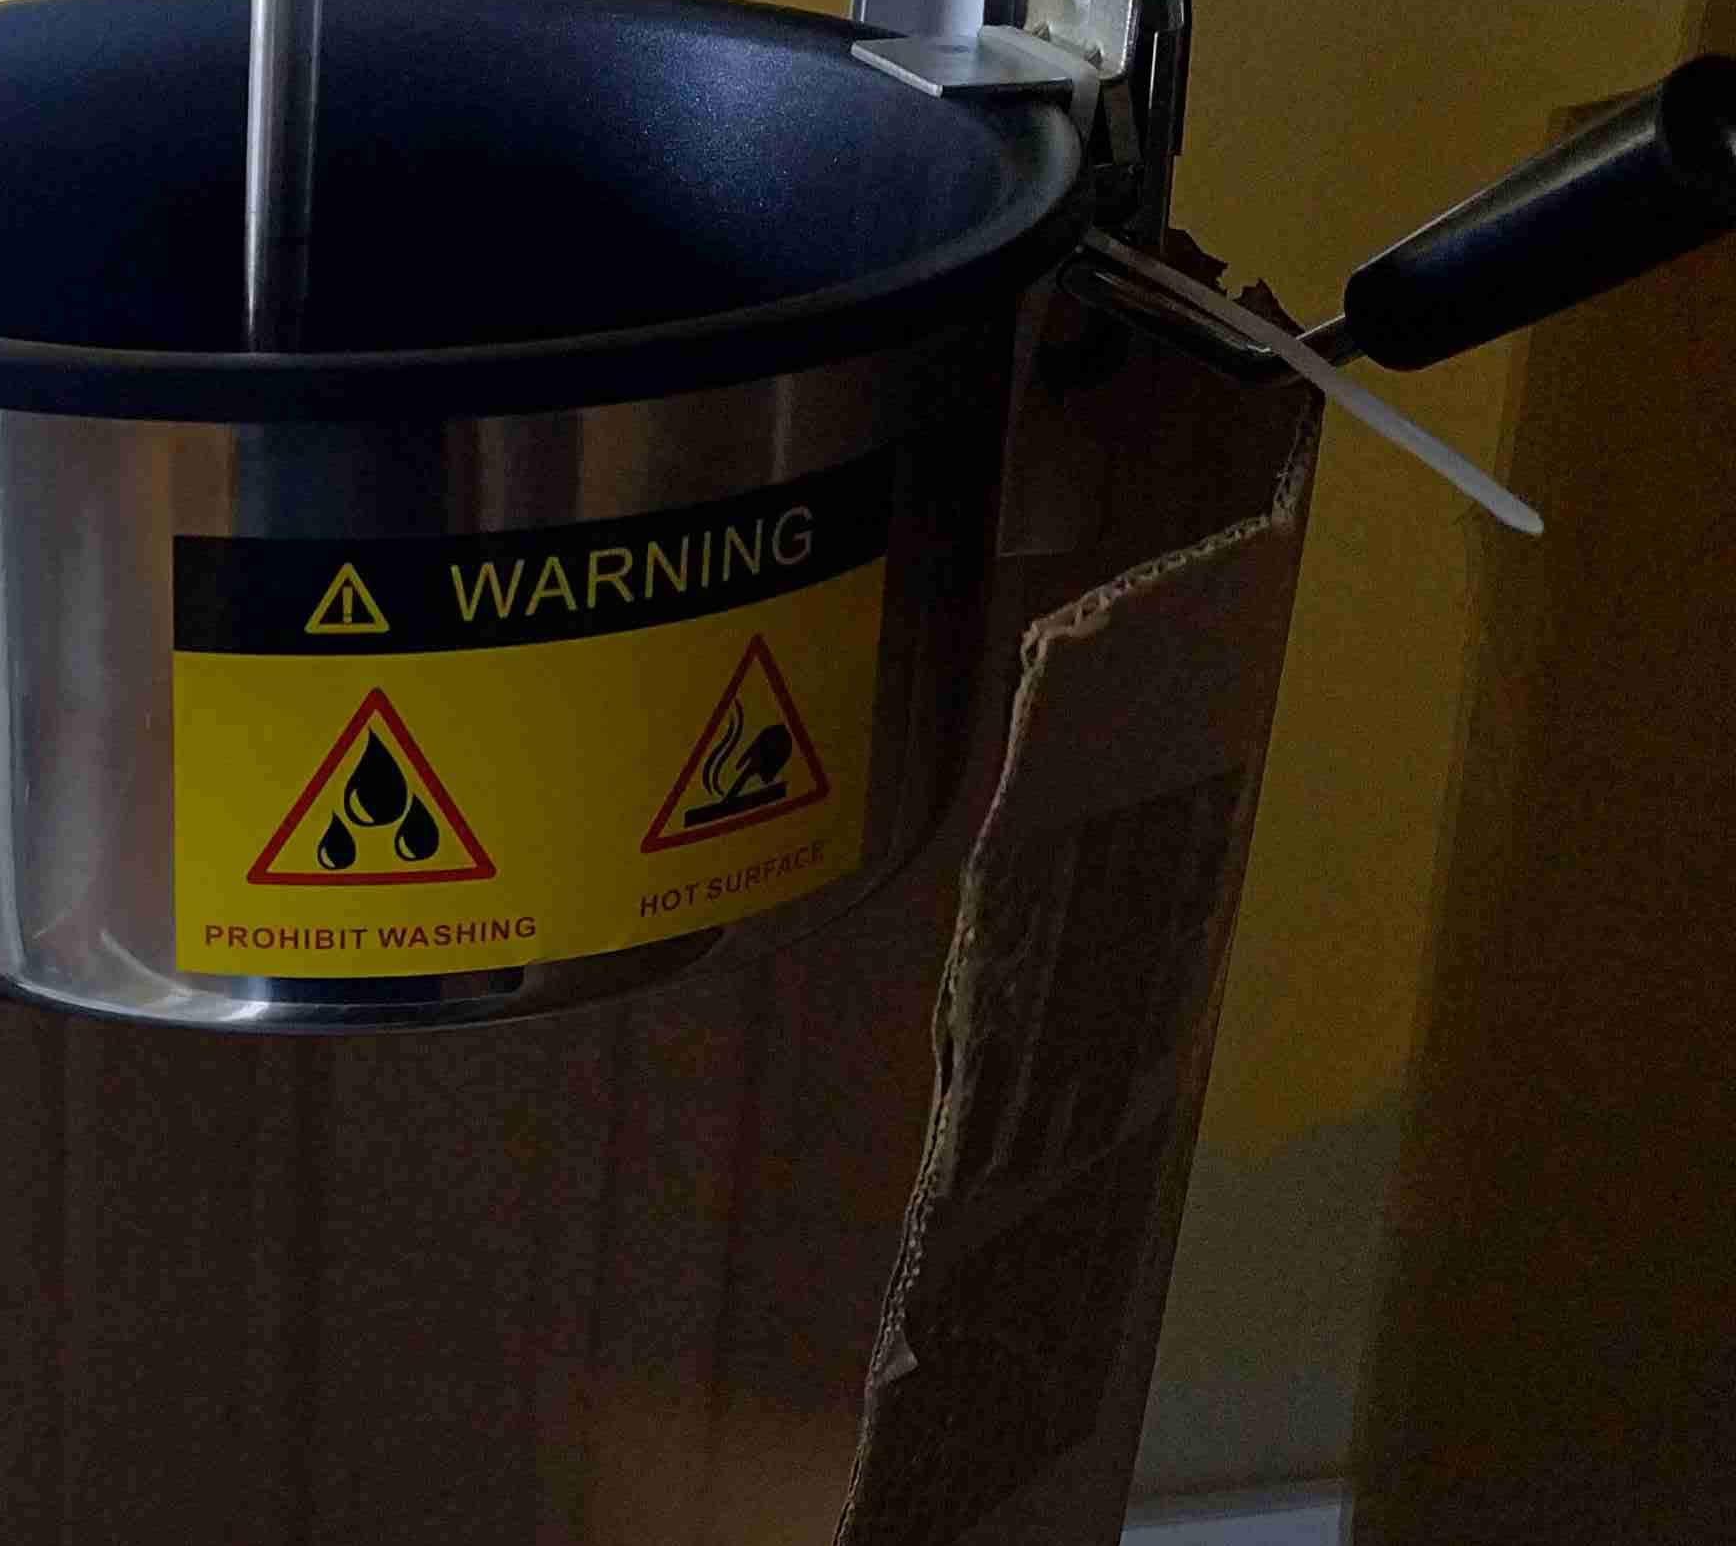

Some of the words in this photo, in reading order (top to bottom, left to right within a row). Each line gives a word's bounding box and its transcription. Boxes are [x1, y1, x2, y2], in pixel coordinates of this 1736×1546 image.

[448, 504, 816, 623] WARNING
[639, 882, 700, 919] HOT
[705, 841, 827, 902] SURFACE
[204, 923, 368, 951] PROHIBIT
[377, 915, 539, 949] WASHING
